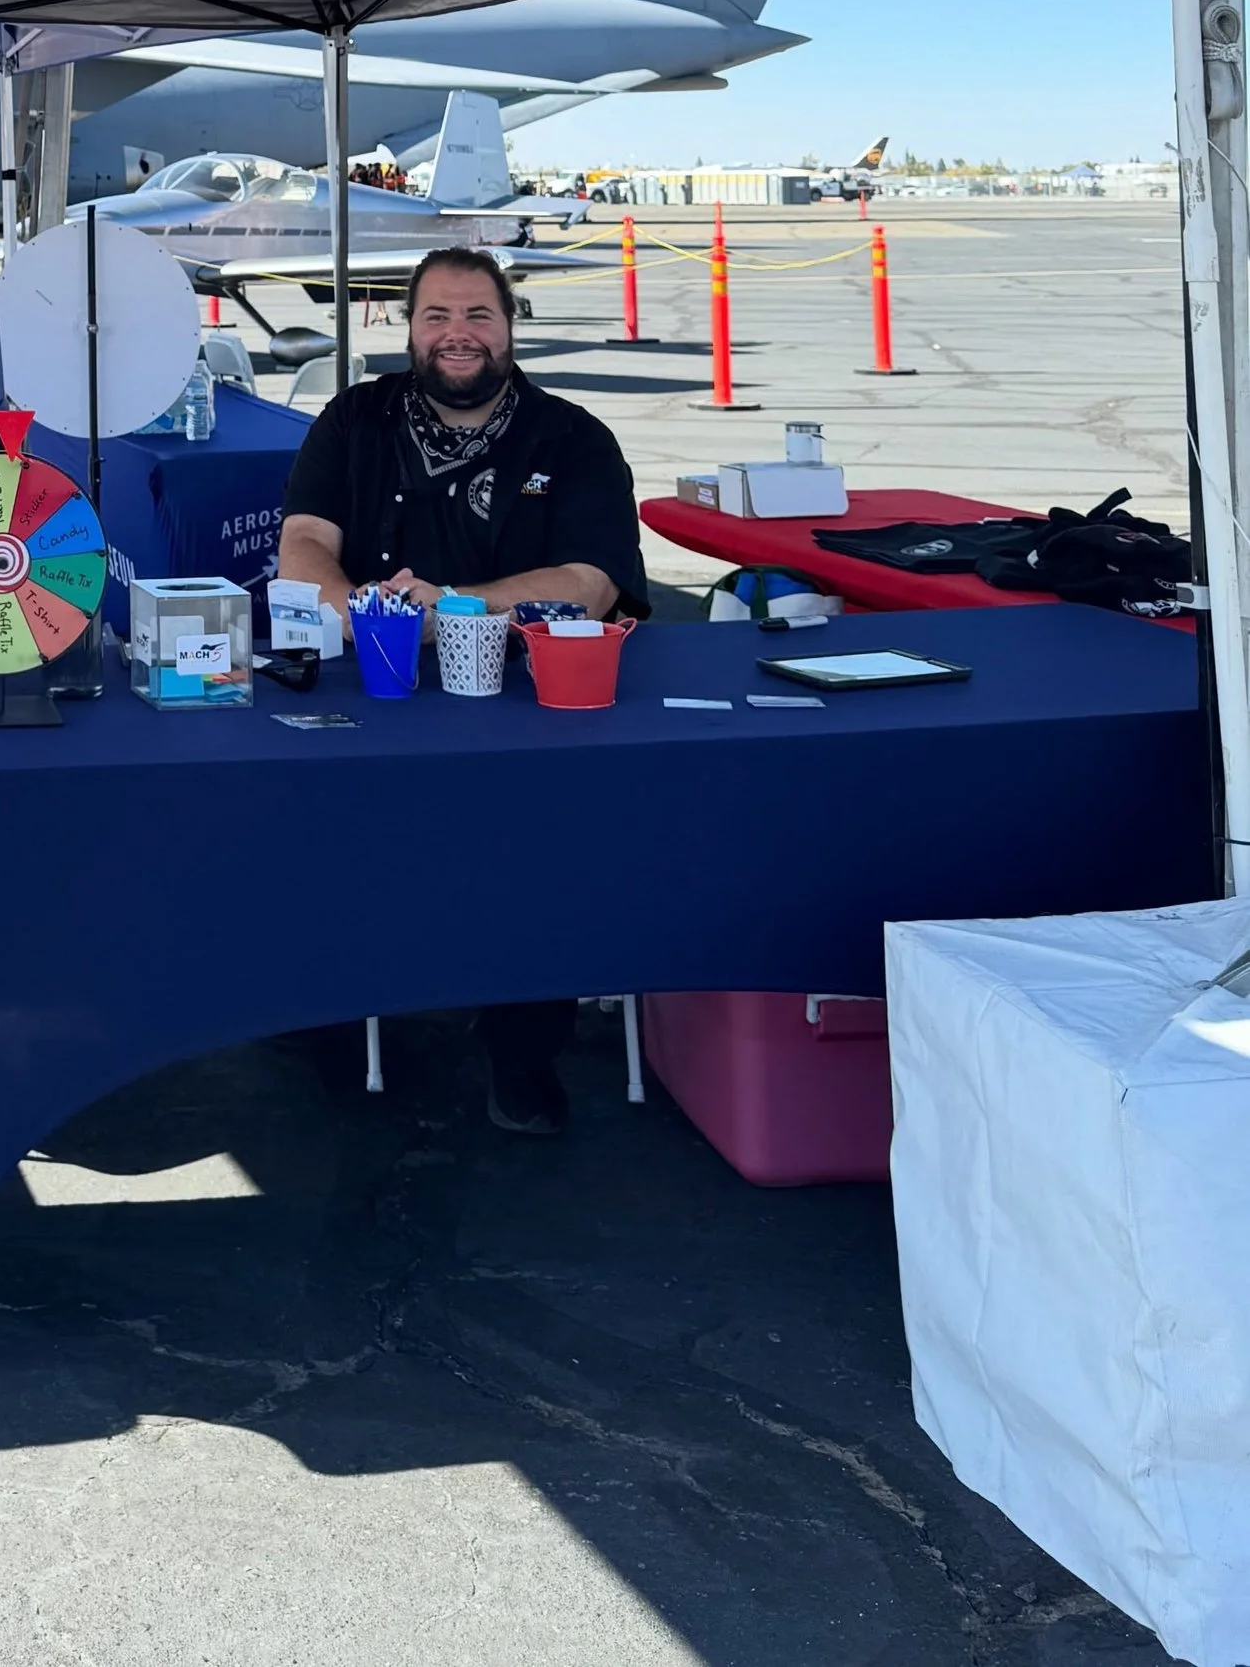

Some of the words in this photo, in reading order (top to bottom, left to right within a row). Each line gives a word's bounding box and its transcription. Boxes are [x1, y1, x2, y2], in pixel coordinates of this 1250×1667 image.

[221, 507, 283, 539] AEROS
[39, 525, 89, 550] Candy
[233, 531, 279, 558] MUS
[39, 565, 75, 586] Raffle
[78, 574, 93, 588] Tix
[0, 601, 12, 636] Raffle
[1, 637, 13, 654] Tix
[179, 650, 210, 660] MACH
